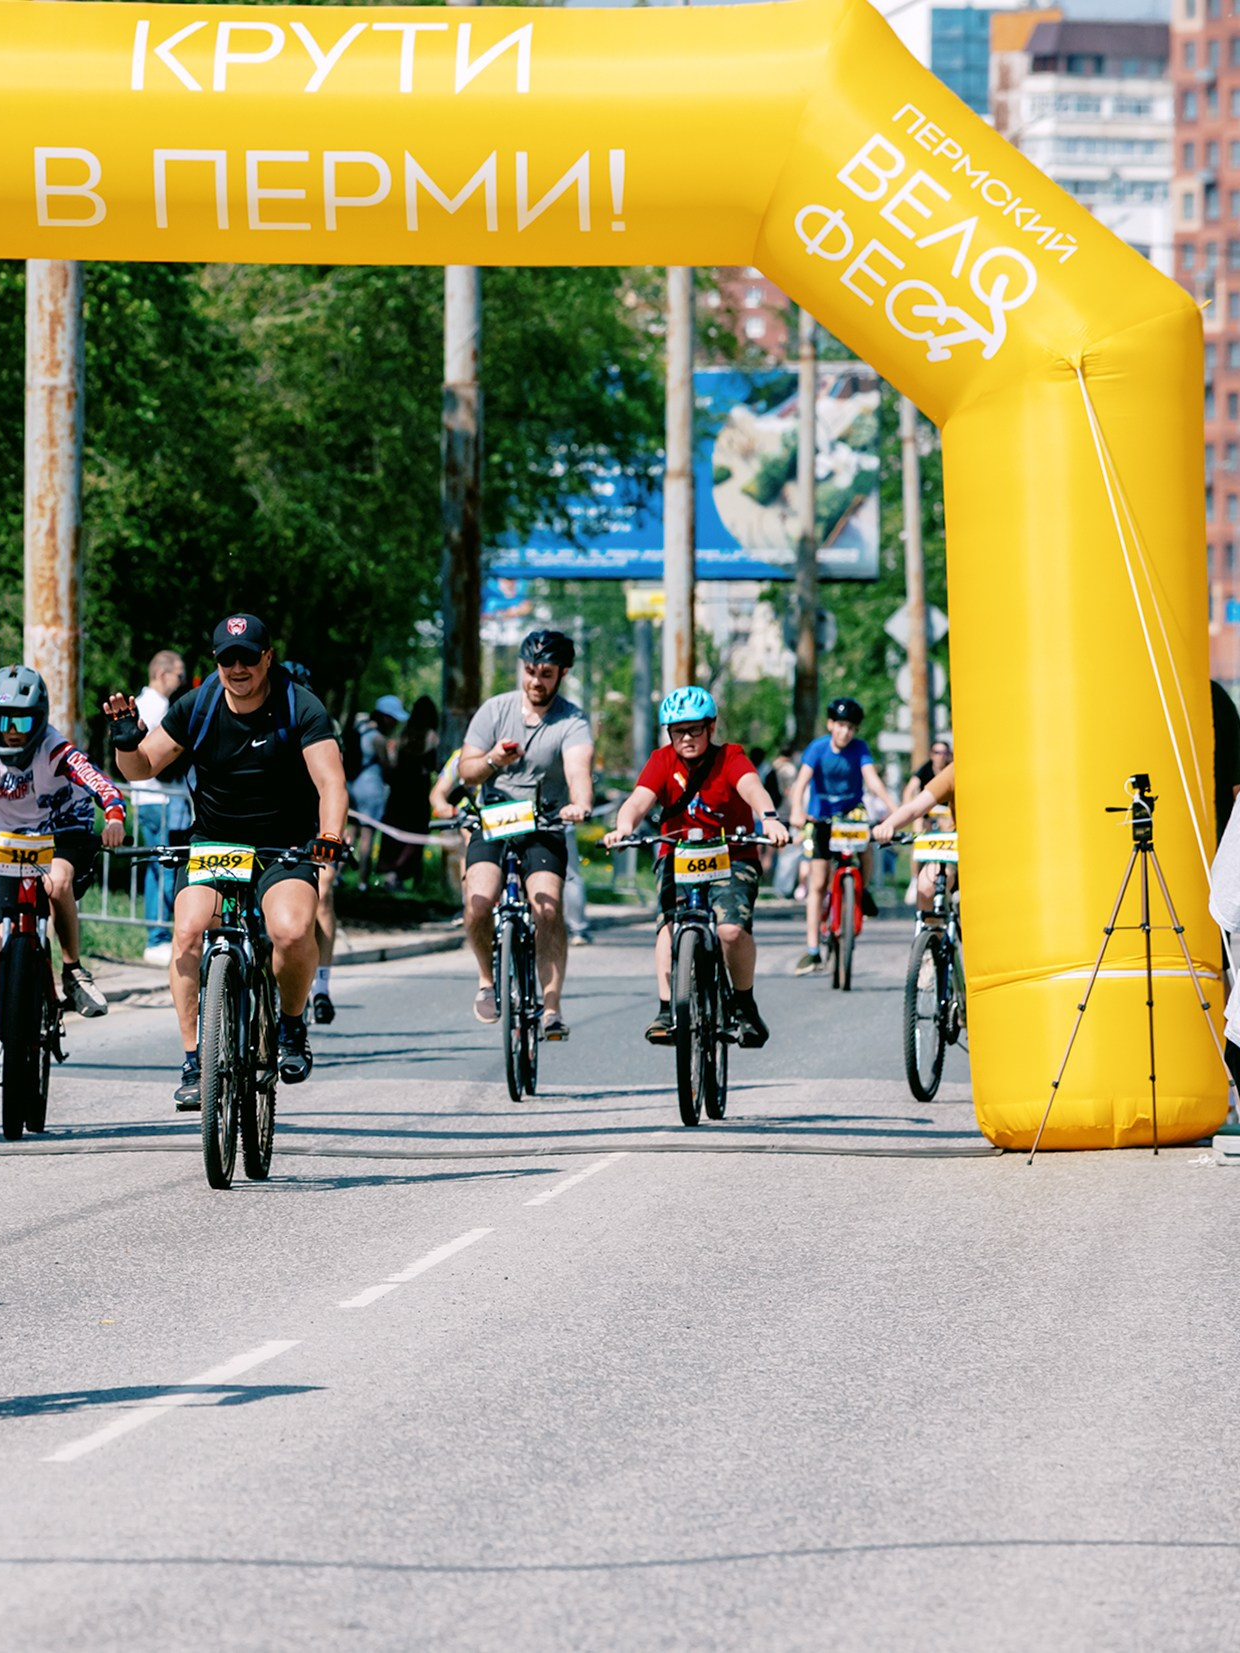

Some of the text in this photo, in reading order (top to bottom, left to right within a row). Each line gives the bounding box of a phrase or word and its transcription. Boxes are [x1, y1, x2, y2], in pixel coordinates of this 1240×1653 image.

[129, 19, 534, 95] КРУТИ
[33, 146, 627, 233] В ПЕРМИ!
[835, 132, 1038, 311] ВЕЛО
[891, 102, 1079, 264] ПЕРМСКИЙ
[793, 203, 1001, 363] ФЕСТ
[198, 855, 243, 870] 1089
[687, 856, 718, 872] 684
